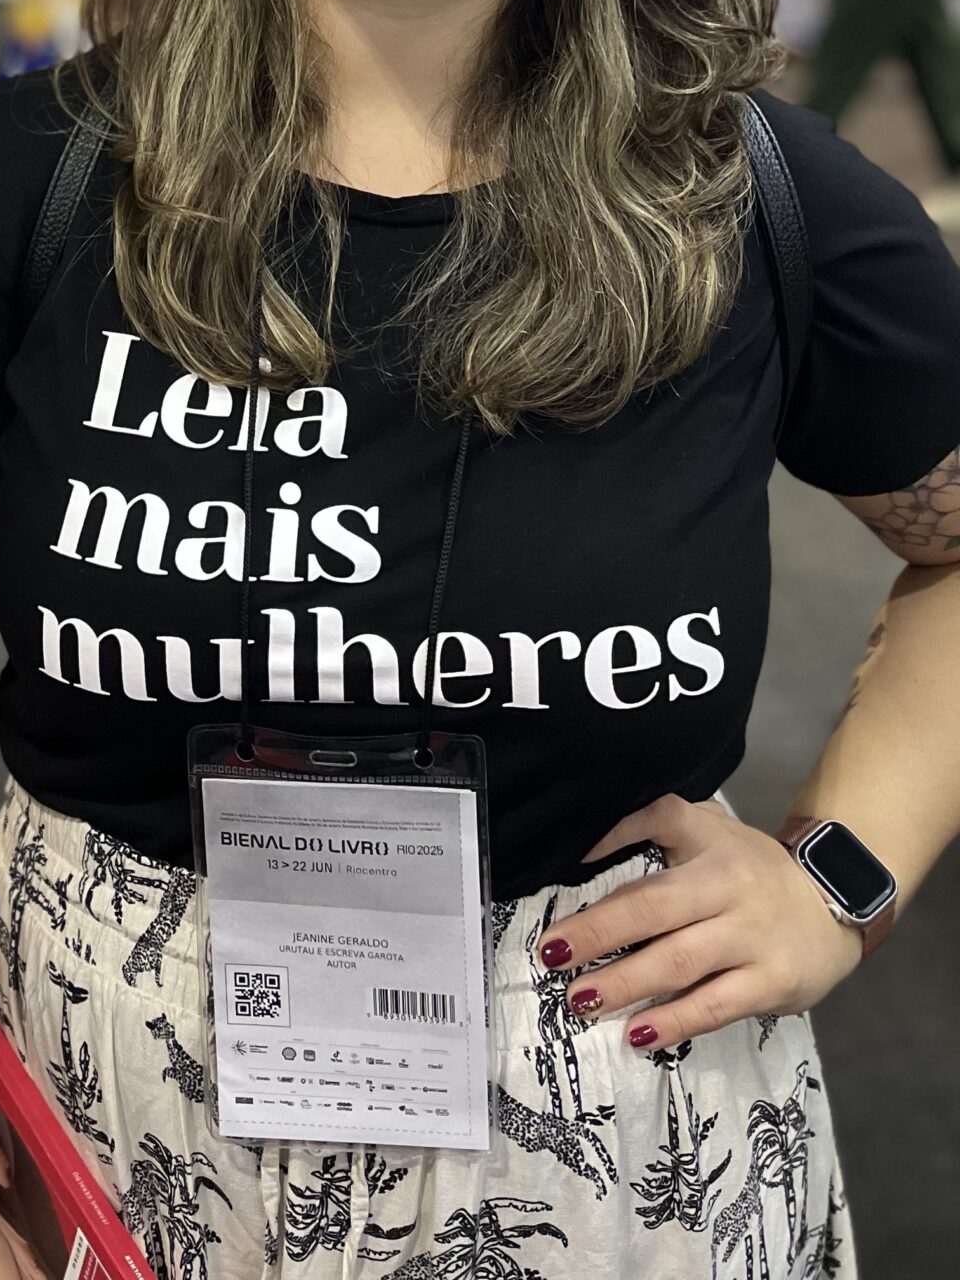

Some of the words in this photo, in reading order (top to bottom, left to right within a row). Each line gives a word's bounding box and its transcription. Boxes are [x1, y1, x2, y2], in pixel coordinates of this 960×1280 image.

[49, 479, 382, 584] mais
[38, 605, 725, 710] mulheres
[220, 831, 291, 851] BIENAL
[267, 859, 279, 870] 13
[292, 861, 307, 872] 22
[310, 862, 333, 873] JUN
[346, 865, 398, 877] Riocentro
[293, 932, 334, 944] JEANINE
[337, 936, 389, 949] GERALDO
[279, 945, 315, 955] URUTAU
[317, 947, 323, 955] E
[325, 948, 365, 959] ESCREVA
[367, 951, 404, 962] GAROTA
[327, 960, 357, 969] AUTOR
